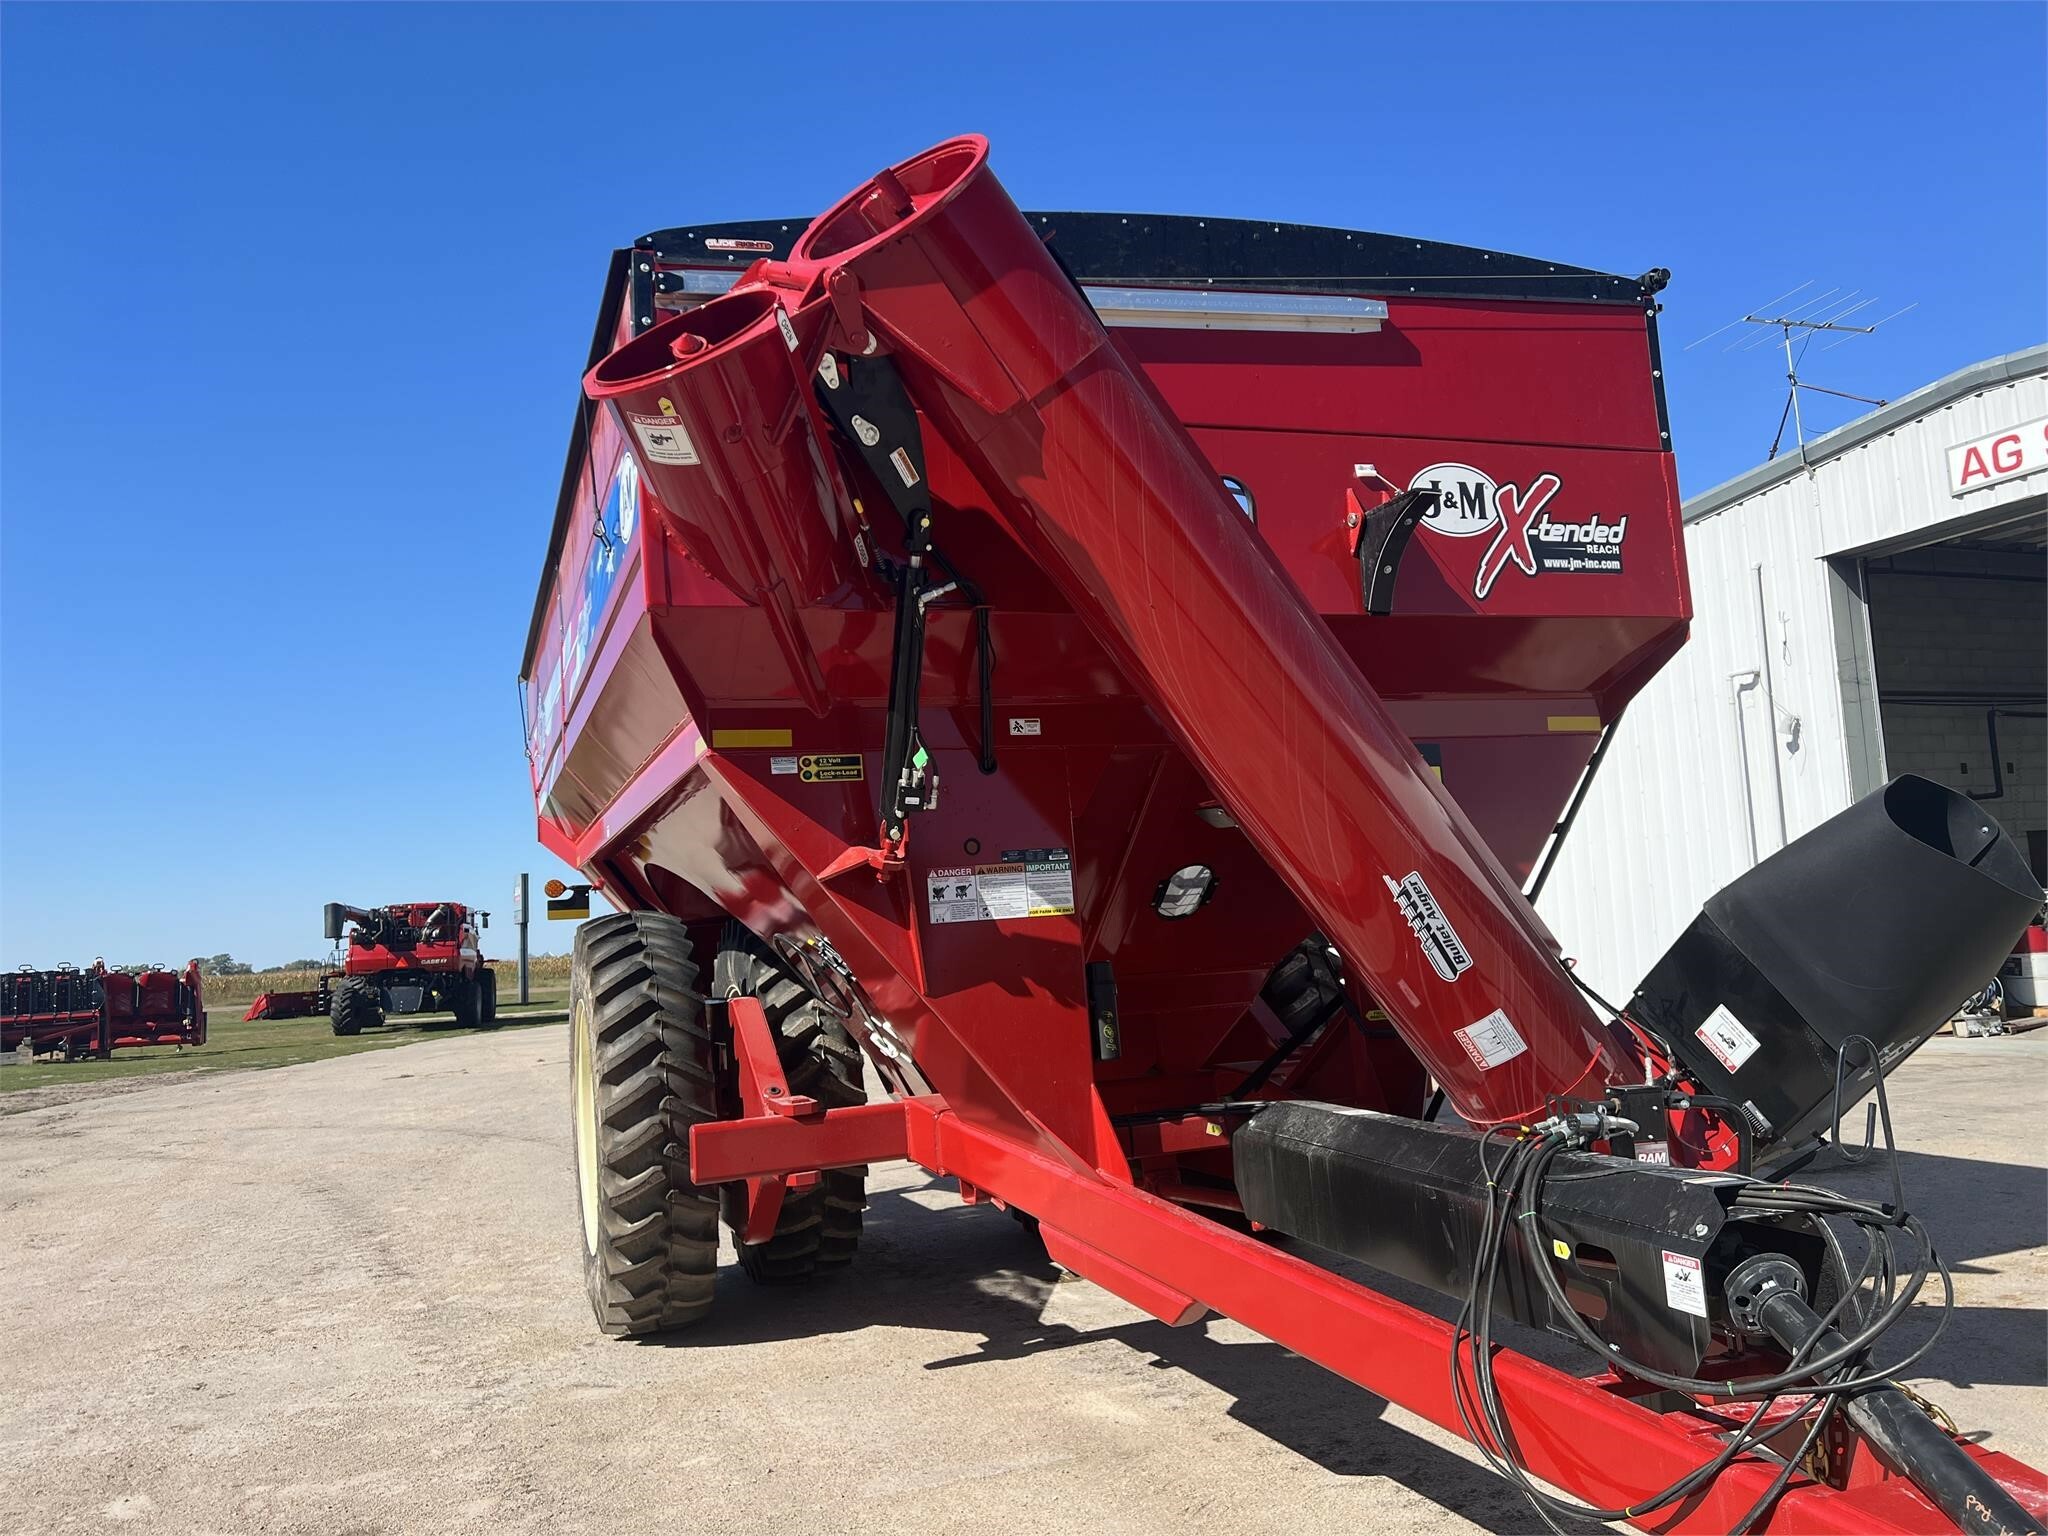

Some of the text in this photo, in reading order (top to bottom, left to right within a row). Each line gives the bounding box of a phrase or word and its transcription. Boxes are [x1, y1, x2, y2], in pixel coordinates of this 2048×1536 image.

[781, 319, 793, 342] OPEN
[641, 417, 676, 426] DANGER
[1961, 434, 2022, 485] AG
[1587, 544, 1620, 555] REACH
[1543, 557, 1620, 571] www.jm-inc.com
[938, 868, 972, 877] DANGER
[986, 865, 1023, 874] WARNING
[1026, 862, 1070, 872] IMPORTANT
[1408, 880, 1467, 965] Bullet Auger
[1457, 1030, 1482, 1062] DANGER
[1700, 1033, 1726, 1061] DANGER
[1638, 1152, 1666, 1164] RAM
[1673, 1256, 1697, 1269] DANGER
